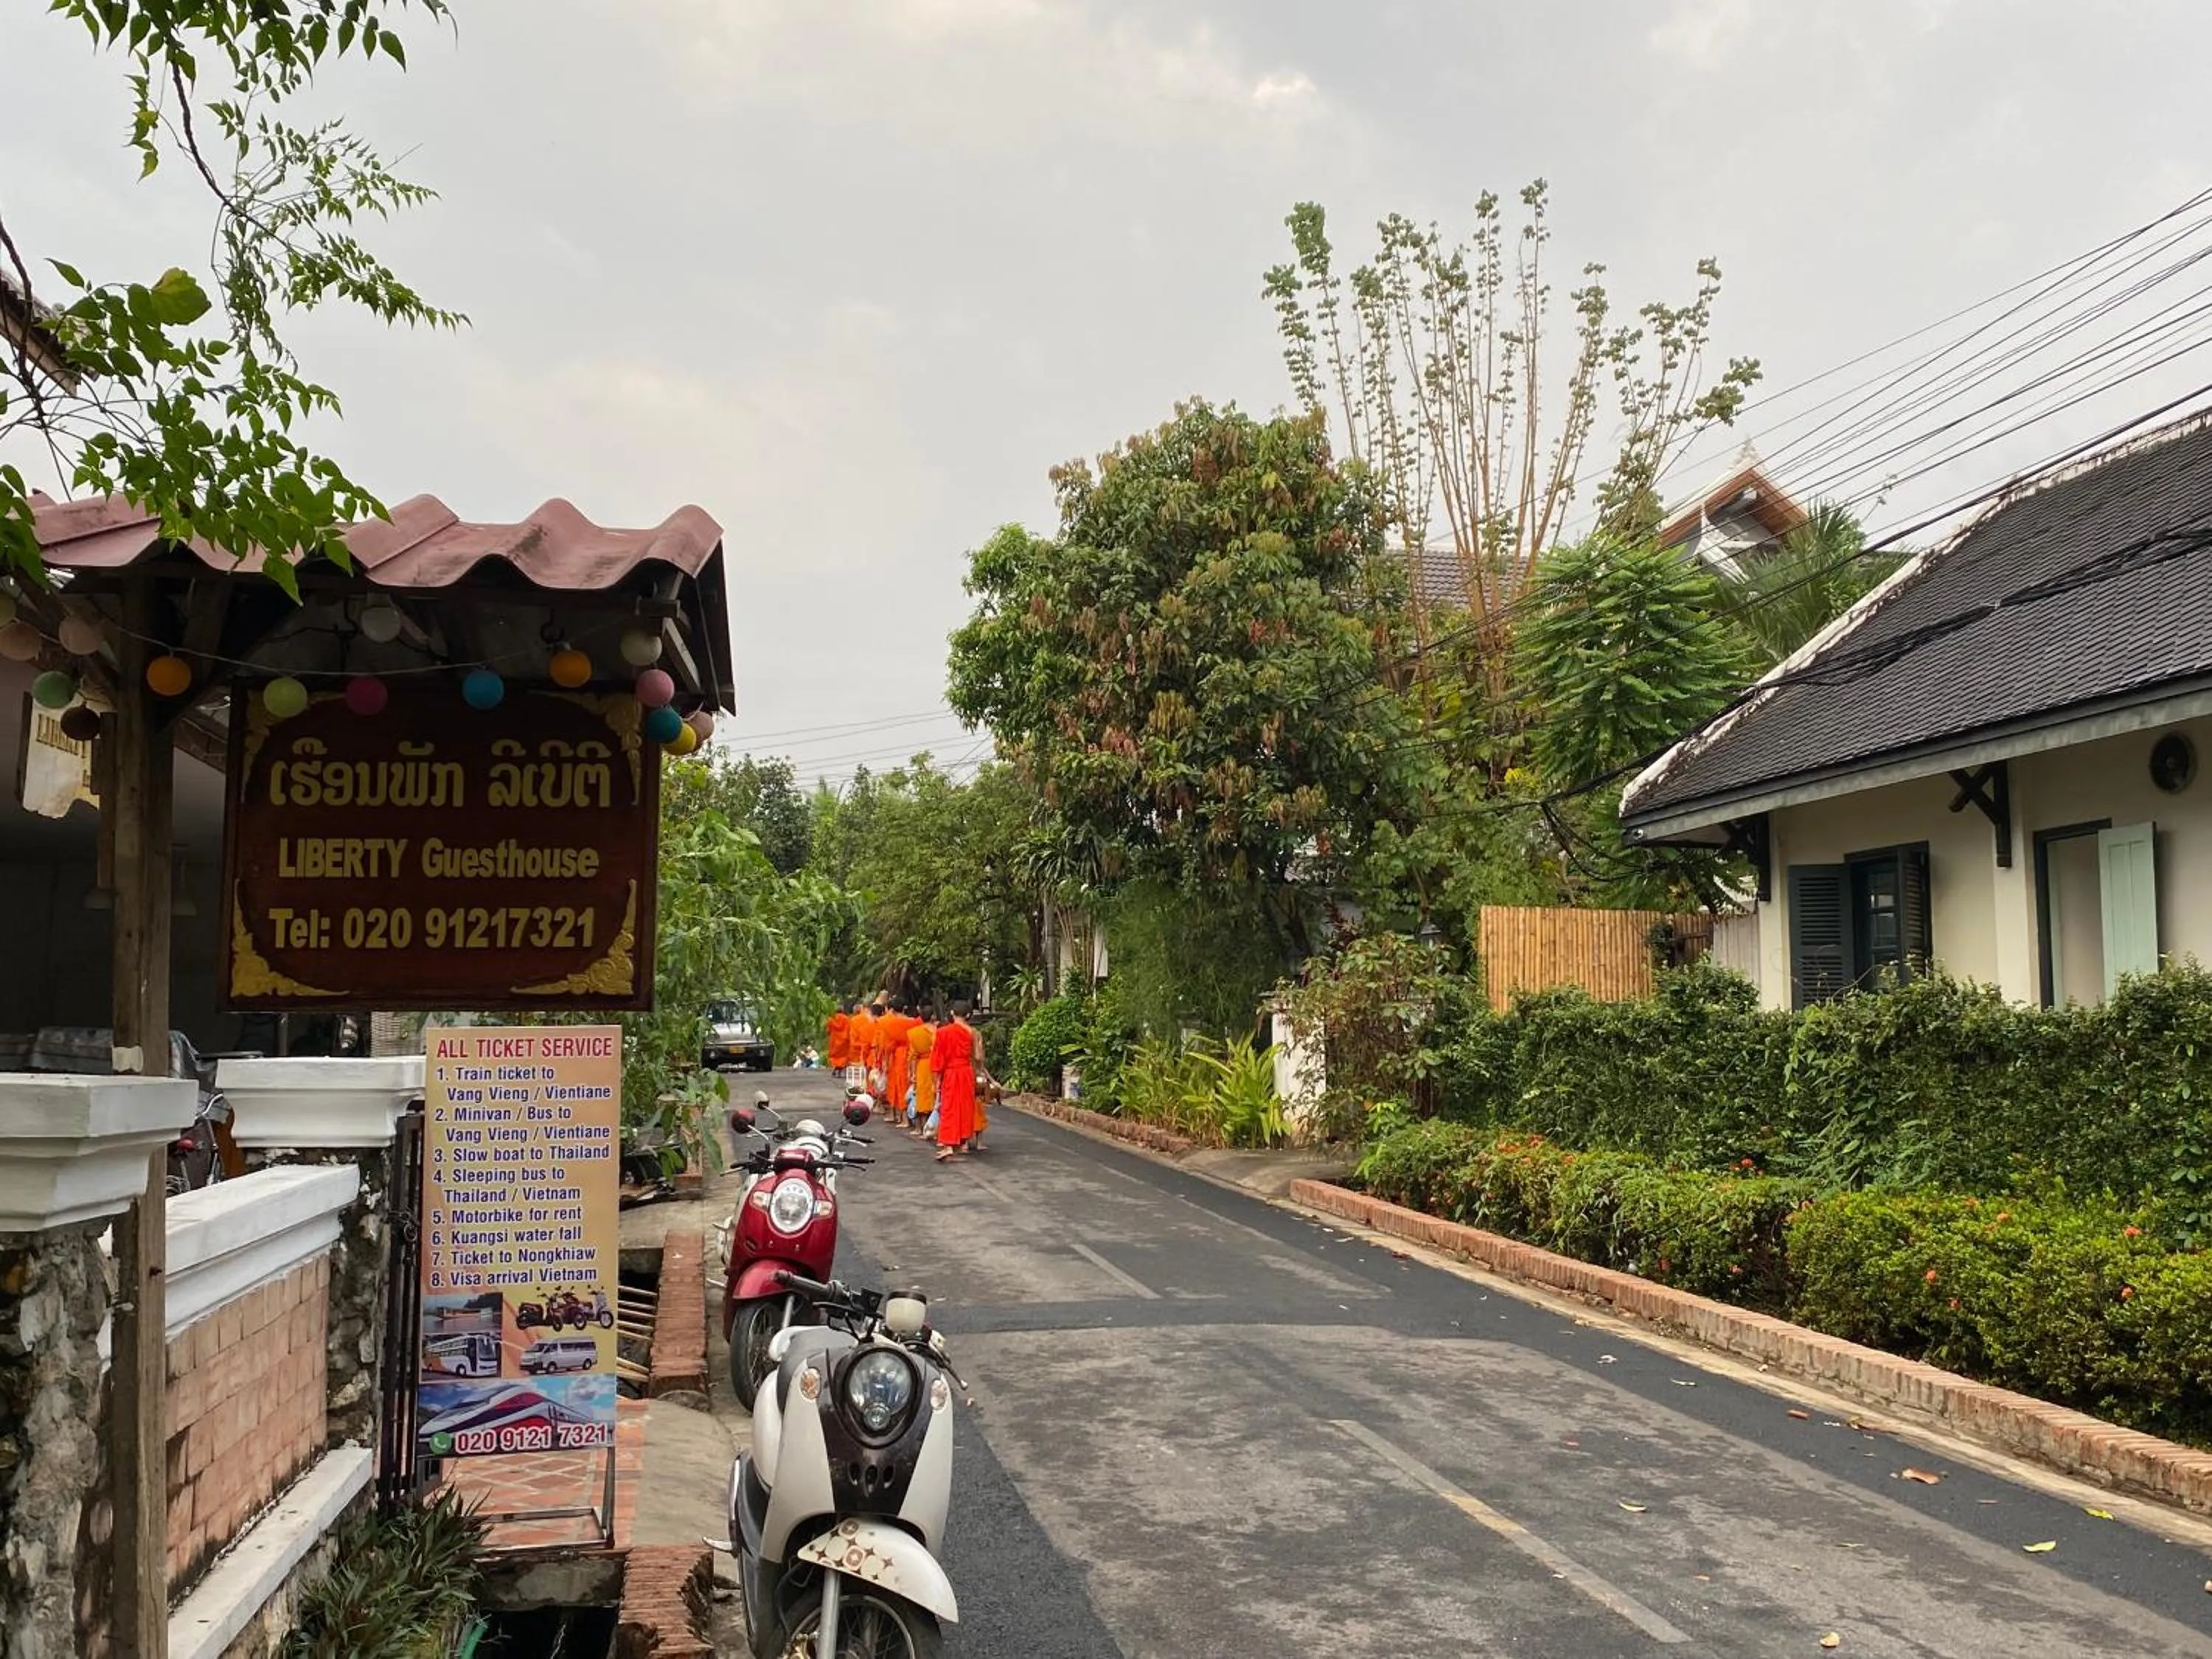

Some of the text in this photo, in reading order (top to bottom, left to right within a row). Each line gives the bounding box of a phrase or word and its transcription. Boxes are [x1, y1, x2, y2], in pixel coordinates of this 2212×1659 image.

[278, 837, 599, 879] LIBERTY Guesthouse
[269, 905, 594, 950] Tel: 020 91217321
[437, 1037, 612, 1059] ALL TICKET SERVICE
[437, 1067, 554, 1081] 1. Train ticket to
[448, 1086, 611, 1103] Vang Vieng / Vientiane
[436, 1105, 571, 1121] 2. Minivan / Bus to
[446, 1126, 611, 1143] Vang Vieng / Vientiane
[434, 1144, 610, 1162] 3. Slow boat to Thailand
[434, 1166, 565, 1184] 4. Sleeping bus to
[444, 1186, 581, 1203] Thailand / Vietnam
[433, 1206, 582, 1224] 5. Motorbike for rent
[432, 1226, 582, 1245] 6. Kuangsi water fall
[432, 1248, 596, 1266] 7. Ticket to Nongkhiaw
[431, 1267, 597, 1287] 8. Visa arrival Vietnam
[458, 1425, 606, 1451] 020 9121 7321
